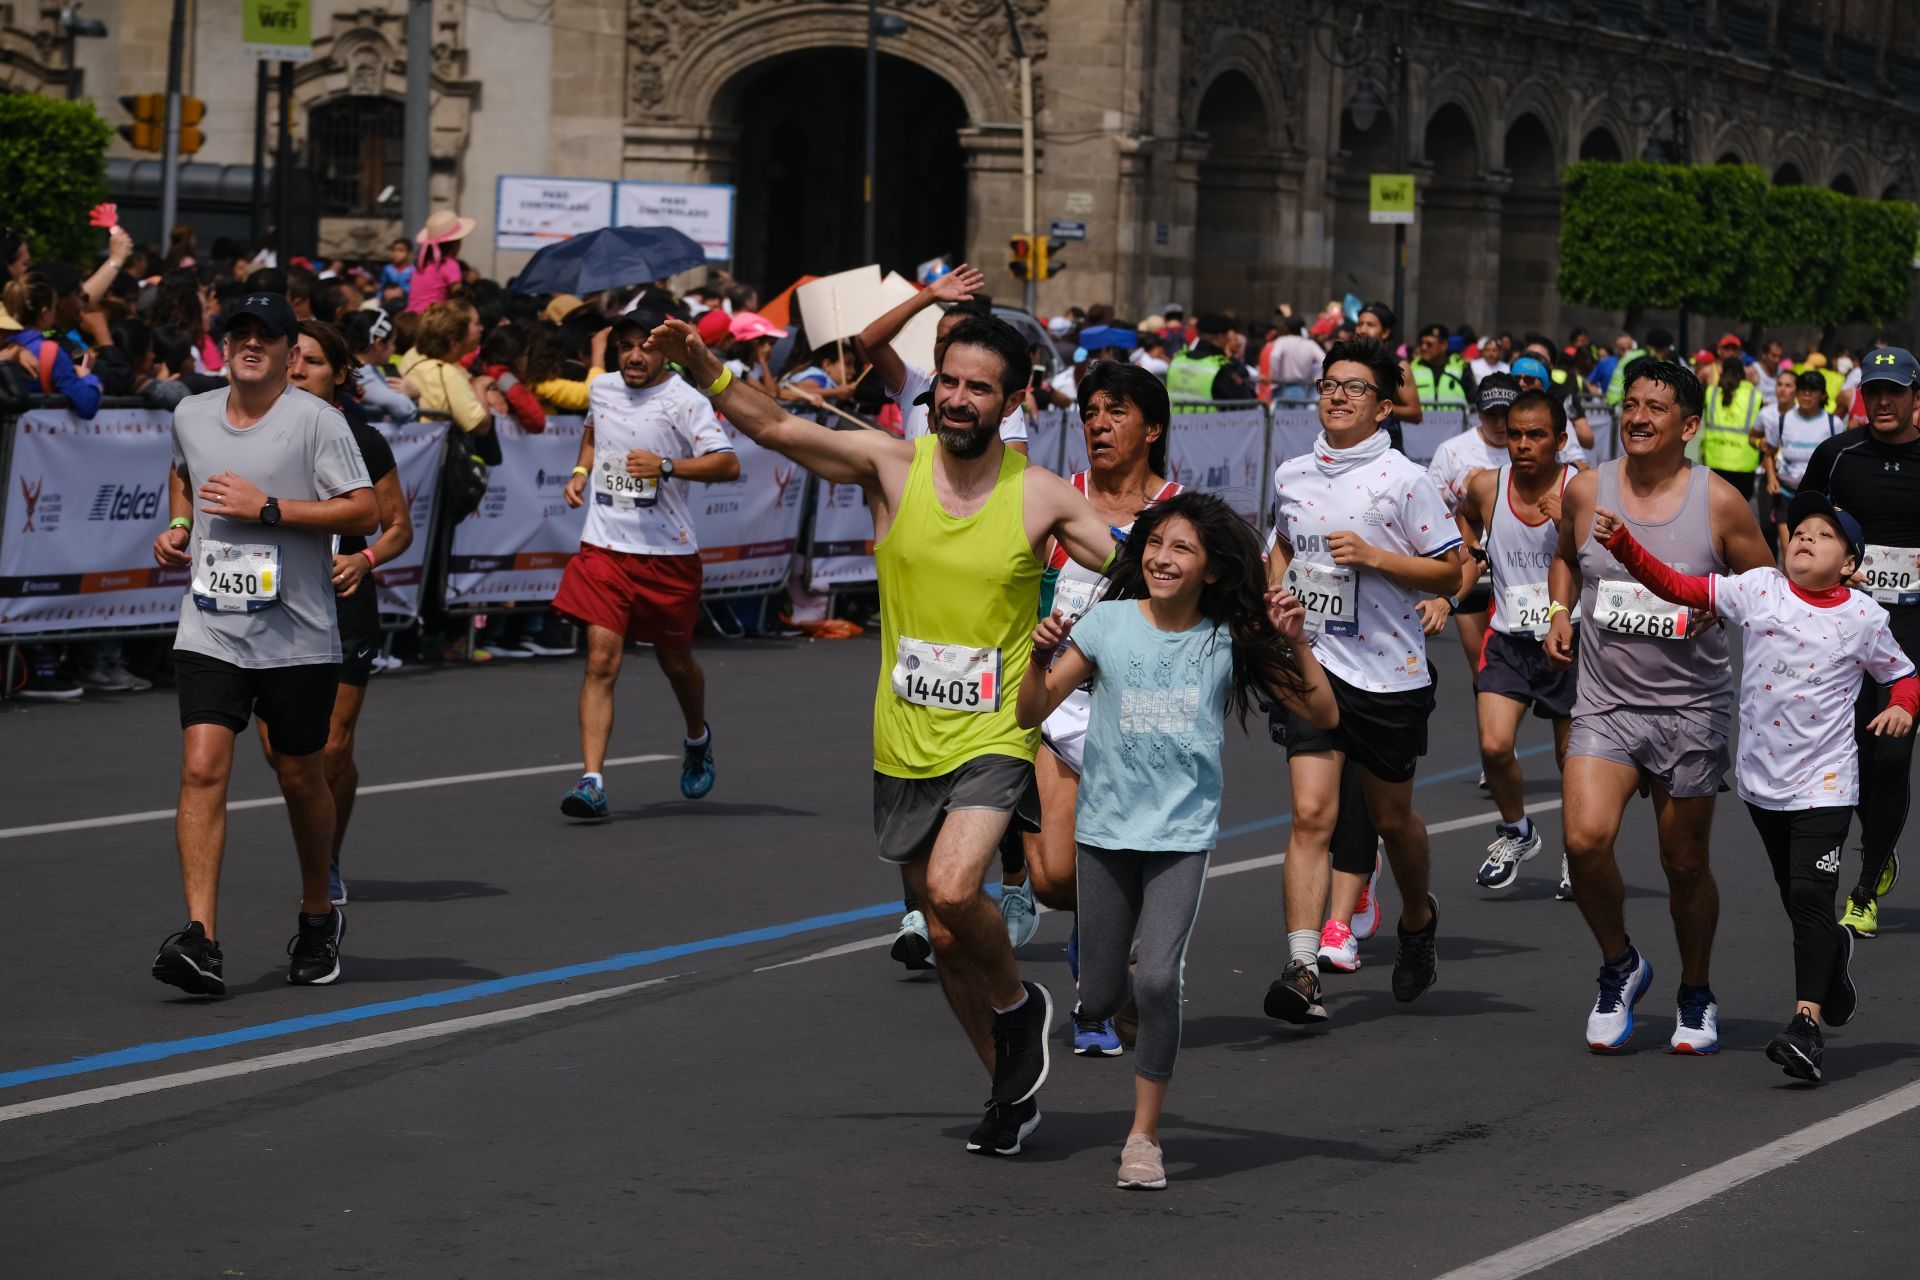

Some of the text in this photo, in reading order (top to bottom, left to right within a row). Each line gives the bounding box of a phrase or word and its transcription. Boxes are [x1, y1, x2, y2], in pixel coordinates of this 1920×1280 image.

[257, 7, 297, 29] WiFi
[606, 475, 643, 493] 5849
[109, 483, 165, 521] telcel
[713, 501, 739, 514] DELTA
[1507, 548, 1553, 569] MÉXICO
[209, 571, 257, 595] 2430
[1866, 569, 1910, 589] 9630
[1607, 610, 1674, 638] 24268
[1775, 658, 1823, 686] Date
[905, 674, 980, 706] 14403
[1121, 687, 1200, 714] DANCE
